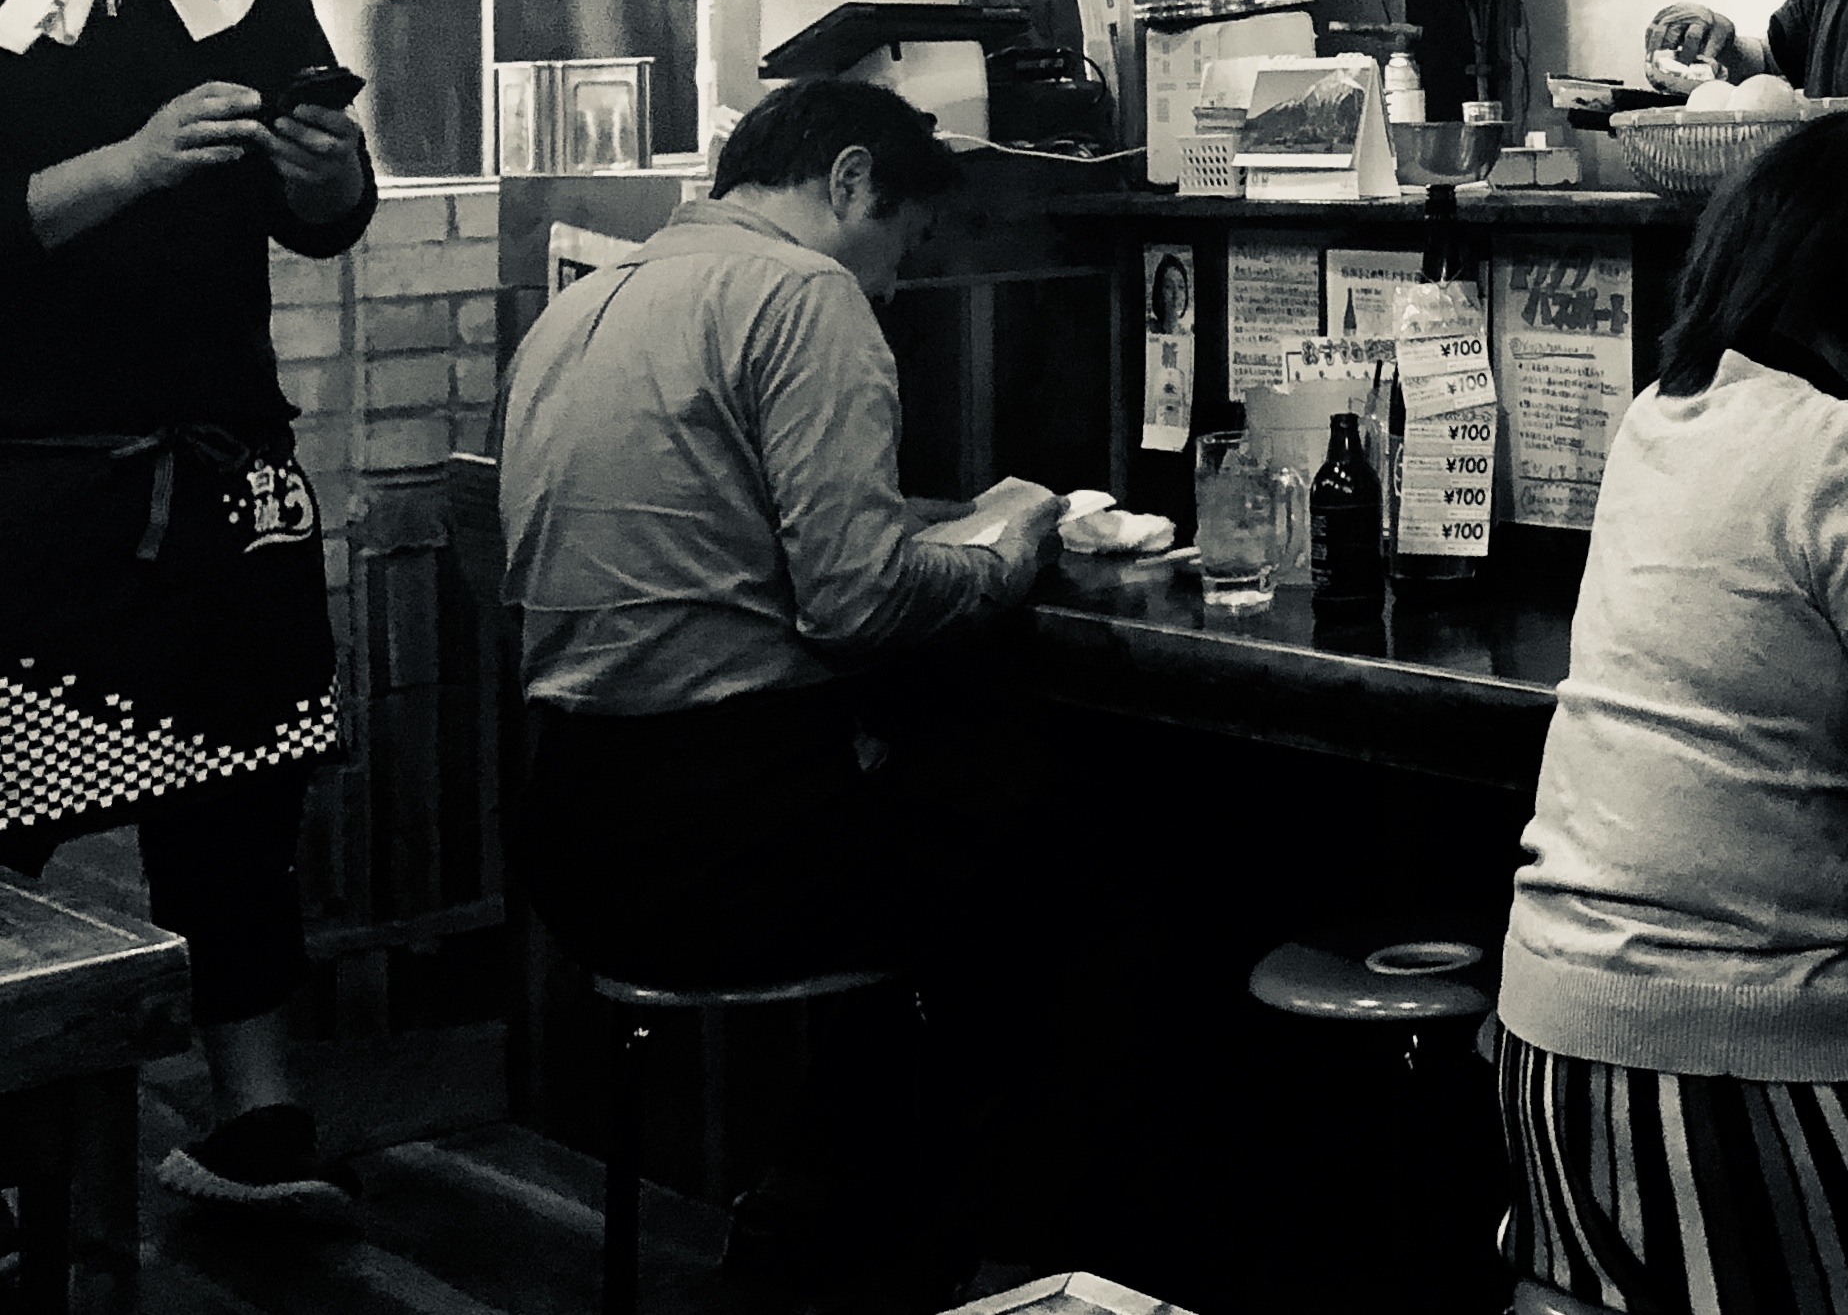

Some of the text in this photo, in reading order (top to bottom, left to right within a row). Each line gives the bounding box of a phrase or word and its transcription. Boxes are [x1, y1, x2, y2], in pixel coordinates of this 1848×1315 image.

[1449, 424, 1491, 442] ¥100
[1446, 457, 1488, 474] ¥100
[1444, 488, 1486, 506] ¥100
[1442, 523, 1484, 541] ¥100
